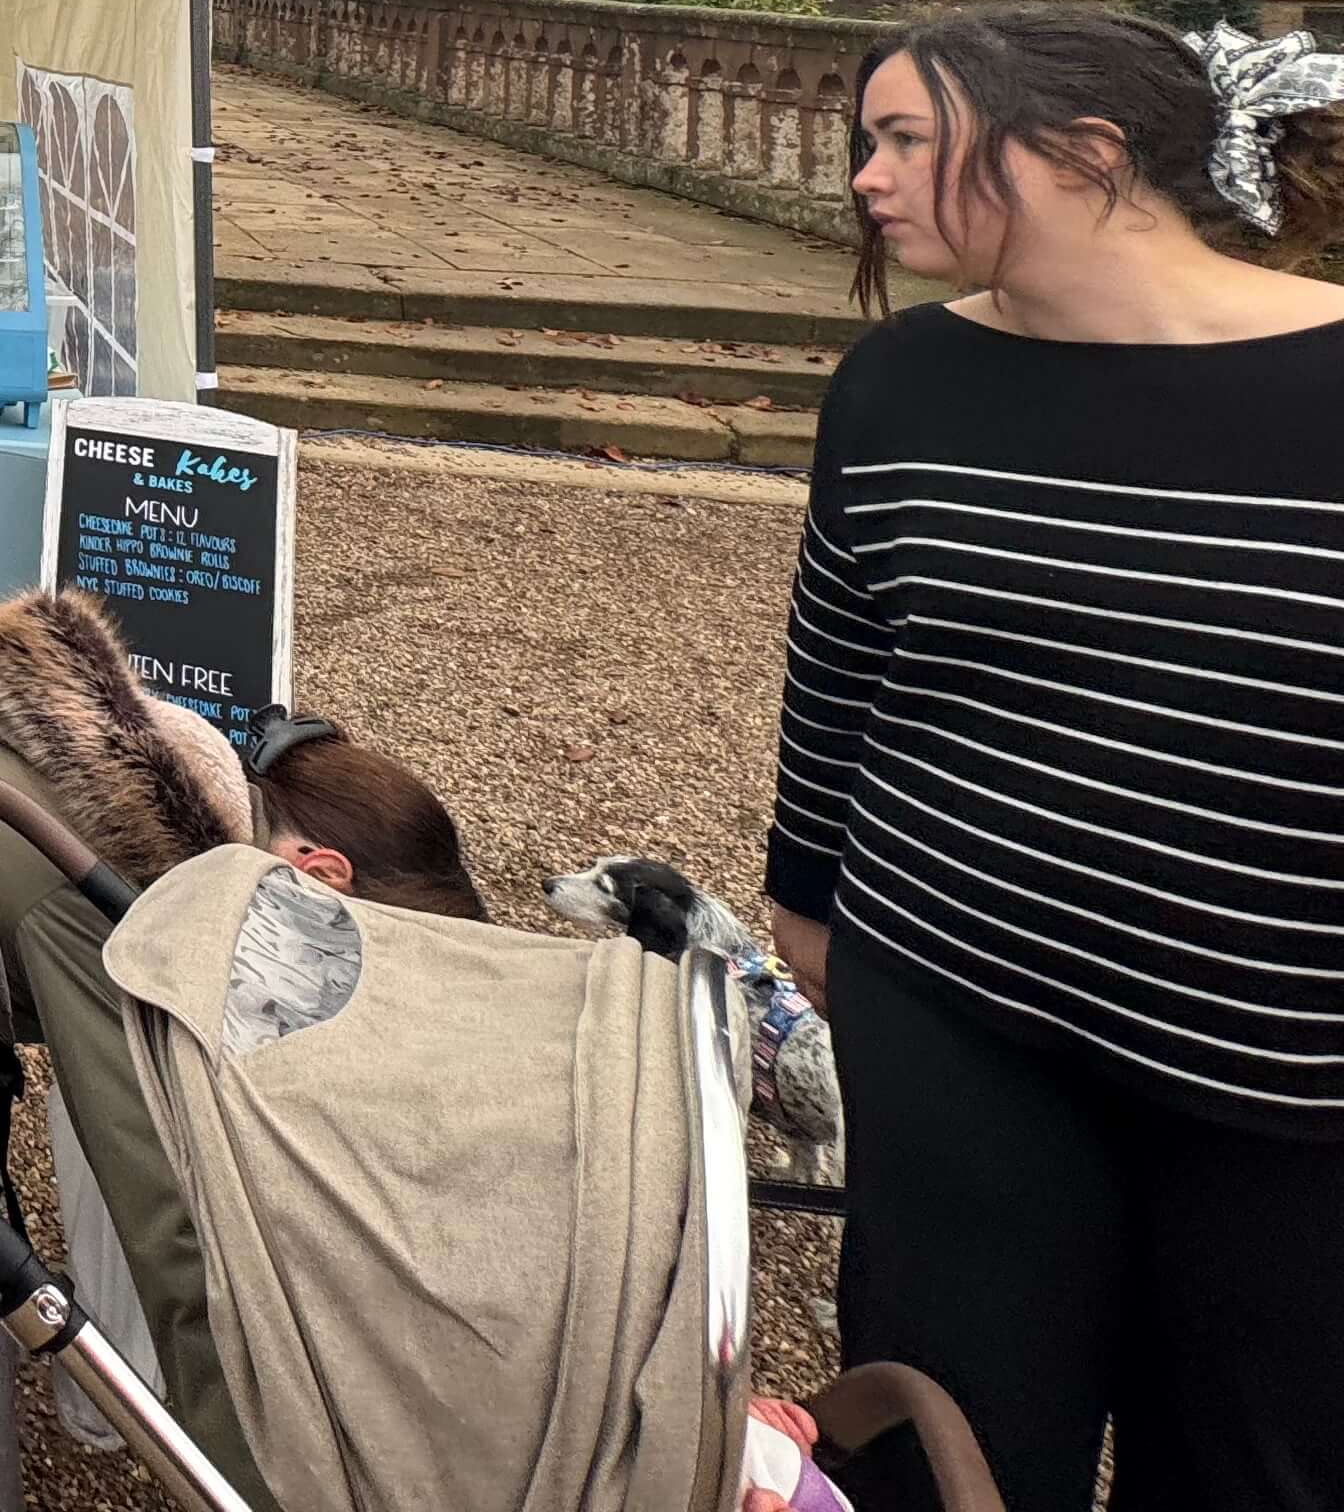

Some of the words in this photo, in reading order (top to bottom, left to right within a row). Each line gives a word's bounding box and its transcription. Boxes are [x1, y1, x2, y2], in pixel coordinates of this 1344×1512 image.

[74, 438, 155, 467] CHEESE
[175, 449, 258, 491] Kakes
[132, 472, 145, 486] &
[148, 474, 193, 493] BAKES
[124, 496, 199, 528] MENU
[79, 513, 134, 536] CHEESECAKE
[176, 531, 187, 546] 12
[190, 532, 236, 554] FLAVOURS
[78, 553, 118, 576] STUFFED
[79, 534, 112, 553] KINDER
[116, 536, 144, 555] HIPPO
[149, 541, 193, 563] BROWNIE
[200, 550, 230, 570] ROLLS
[77, 575, 100, 593] NYC
[103, 577, 144, 601] STUFFED
[149, 585, 190, 605] COOKIES
[127, 653, 174, 685] TEN
[180, 663, 234, 697] FREE
[230, 704, 256, 722] POT
